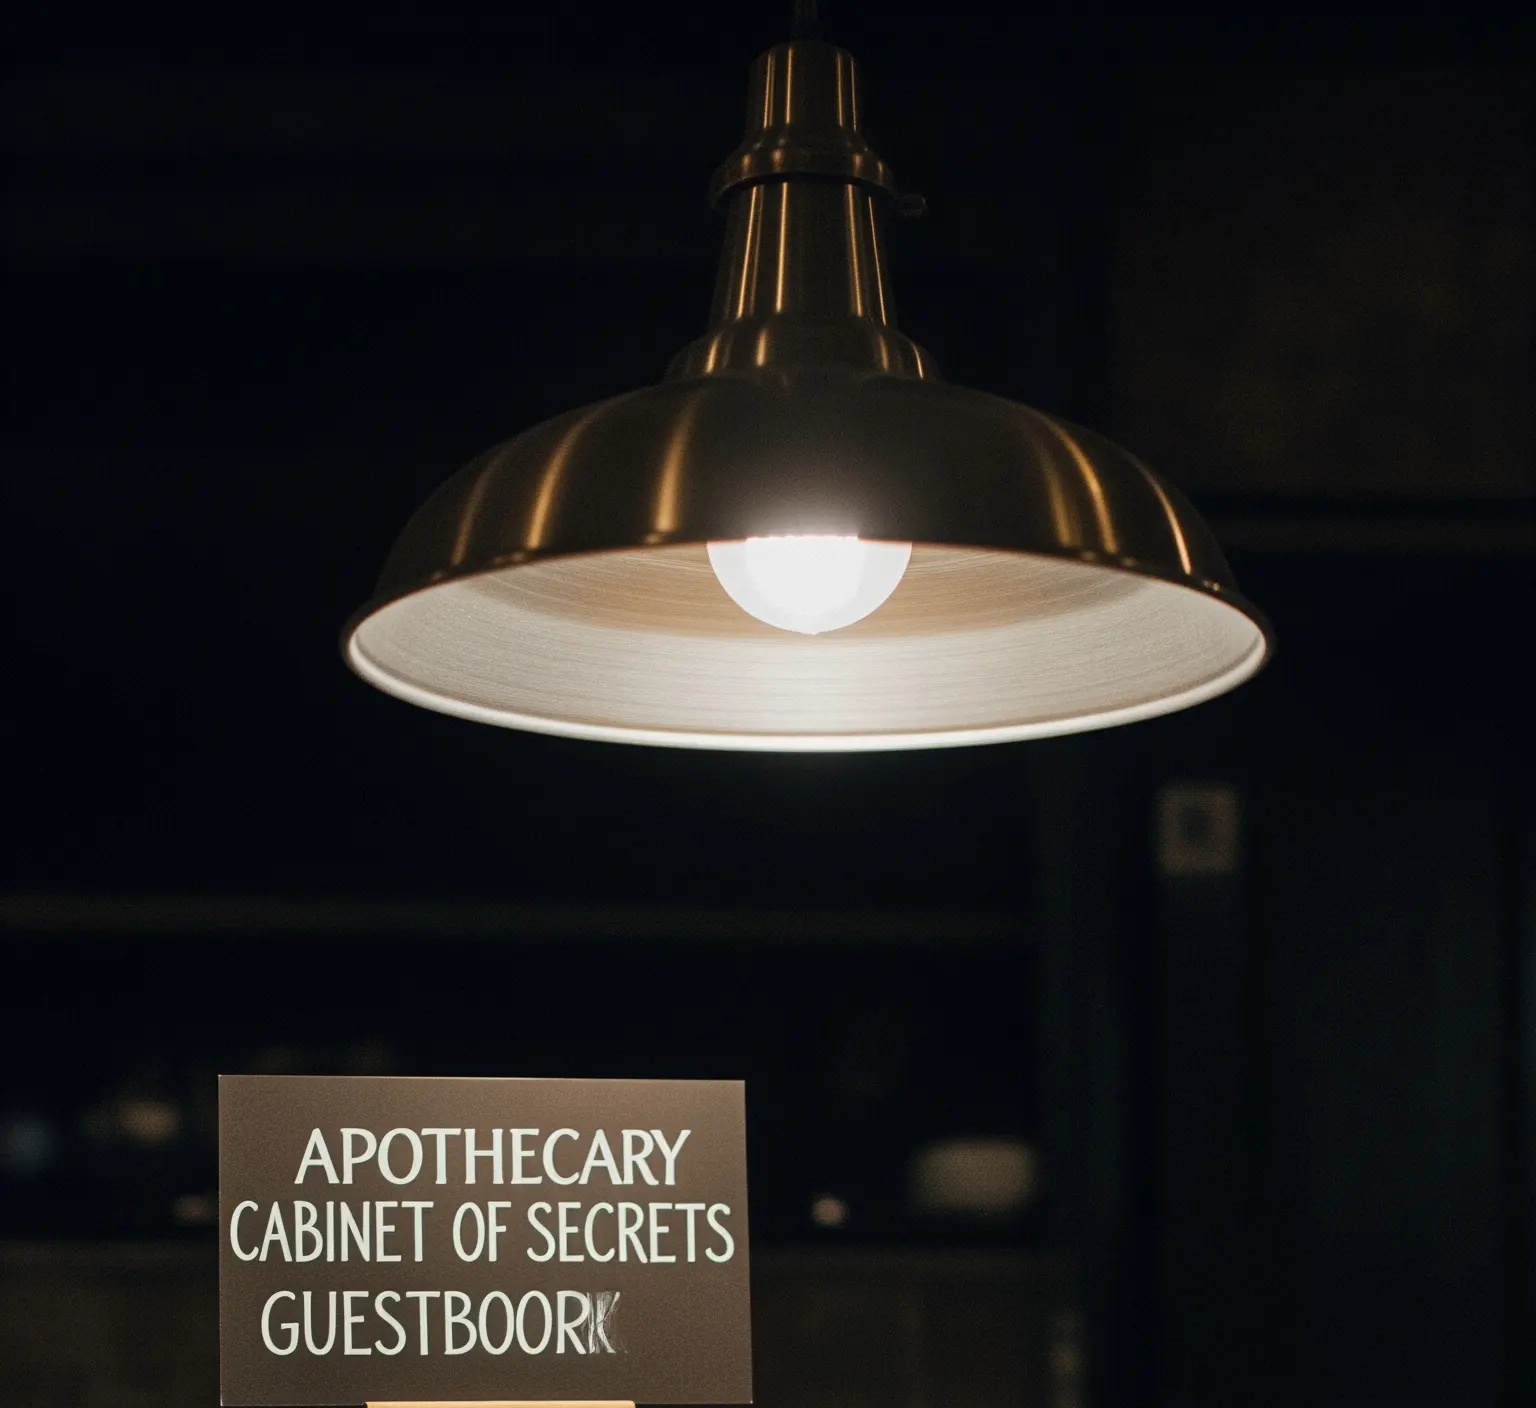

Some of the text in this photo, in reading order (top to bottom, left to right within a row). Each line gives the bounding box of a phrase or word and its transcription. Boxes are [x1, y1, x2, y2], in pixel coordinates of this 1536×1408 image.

[294, 1127, 691, 1186] APOTHECARY
[229, 1200, 735, 1264] CABINET OF SECRETS
